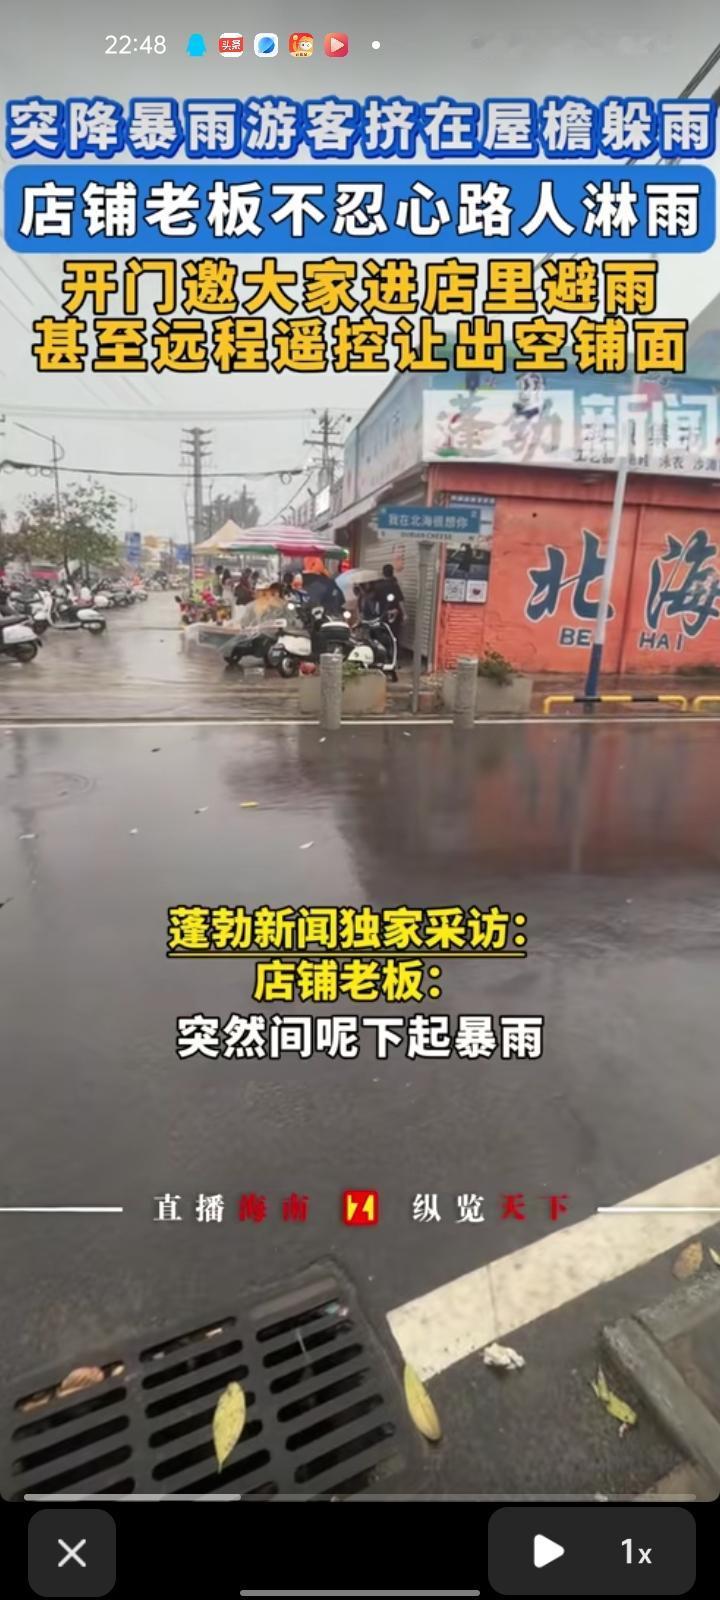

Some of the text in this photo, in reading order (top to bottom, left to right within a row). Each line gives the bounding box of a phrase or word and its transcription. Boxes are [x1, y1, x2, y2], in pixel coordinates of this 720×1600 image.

[388, 512, 469, 529] 我在北海很想你
[559, 627, 596, 647] BE
